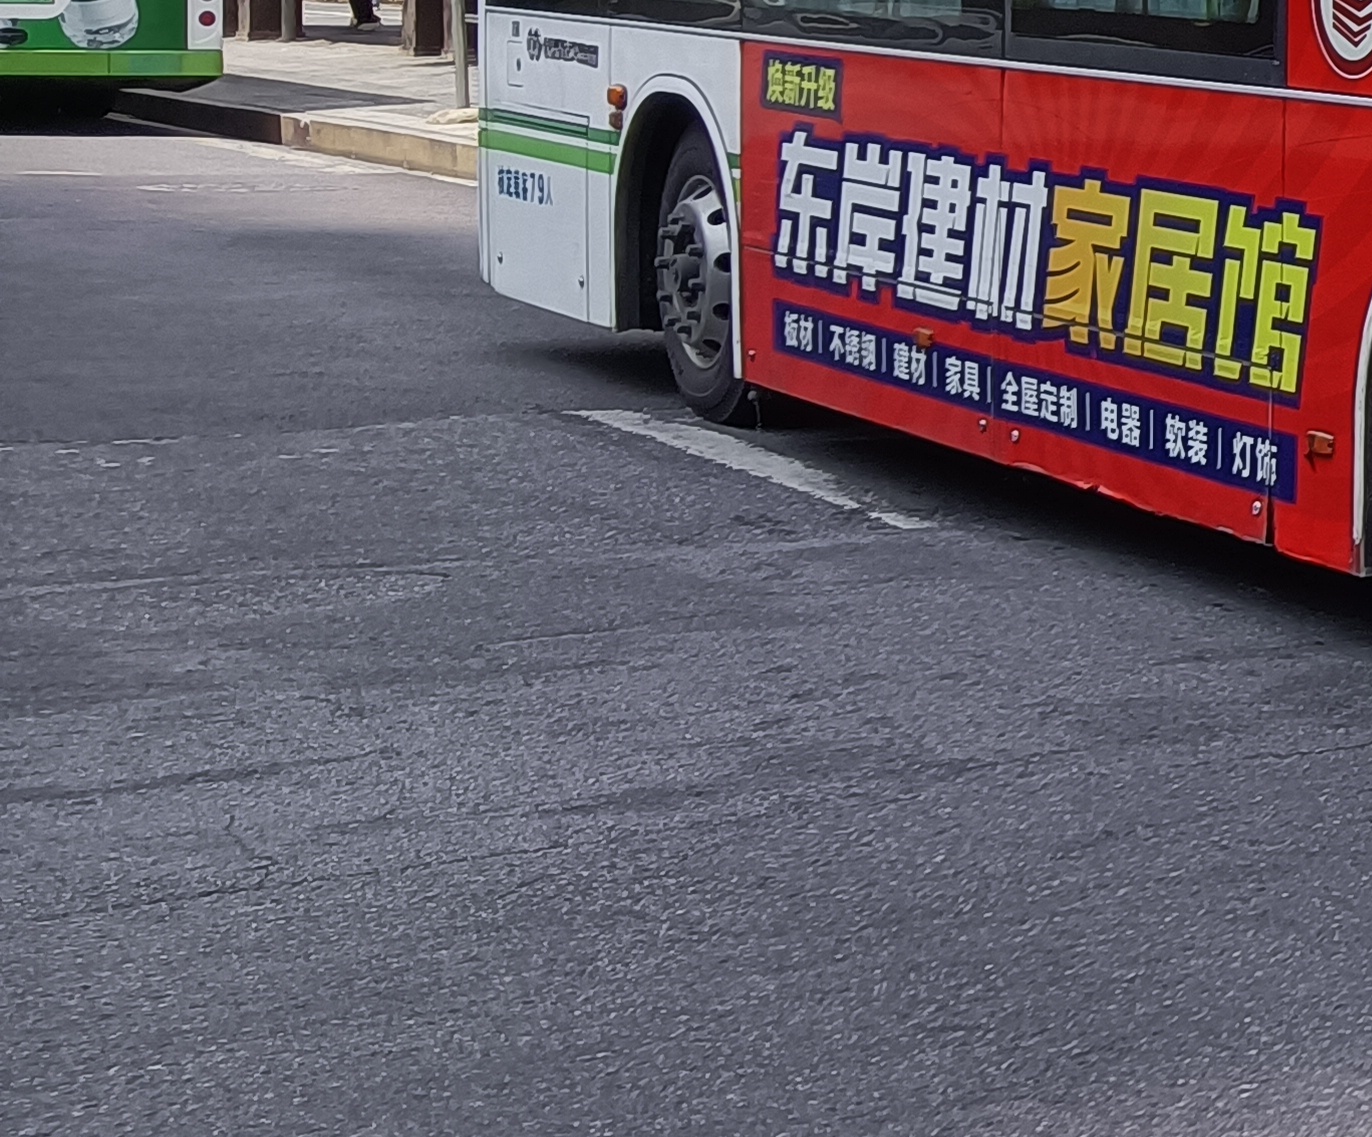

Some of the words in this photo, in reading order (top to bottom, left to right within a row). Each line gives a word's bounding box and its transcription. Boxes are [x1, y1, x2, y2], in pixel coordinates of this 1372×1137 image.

[766, 58, 836, 111] 焕新升级
[773, 131, 1317, 394] 东岸建材家居馆
[783, 310, 813, 353] 板材
[828, 323, 877, 372] 不锈钢
[892, 342, 927, 387] 建材
[943, 356, 981, 401] 家具
[1000, 371, 1078, 430] 全屋定制
[1099, 397, 1141, 449] 电器
[1164, 414, 1208, 466] 软装
[1231, 431, 1278, 486] 灯饰
